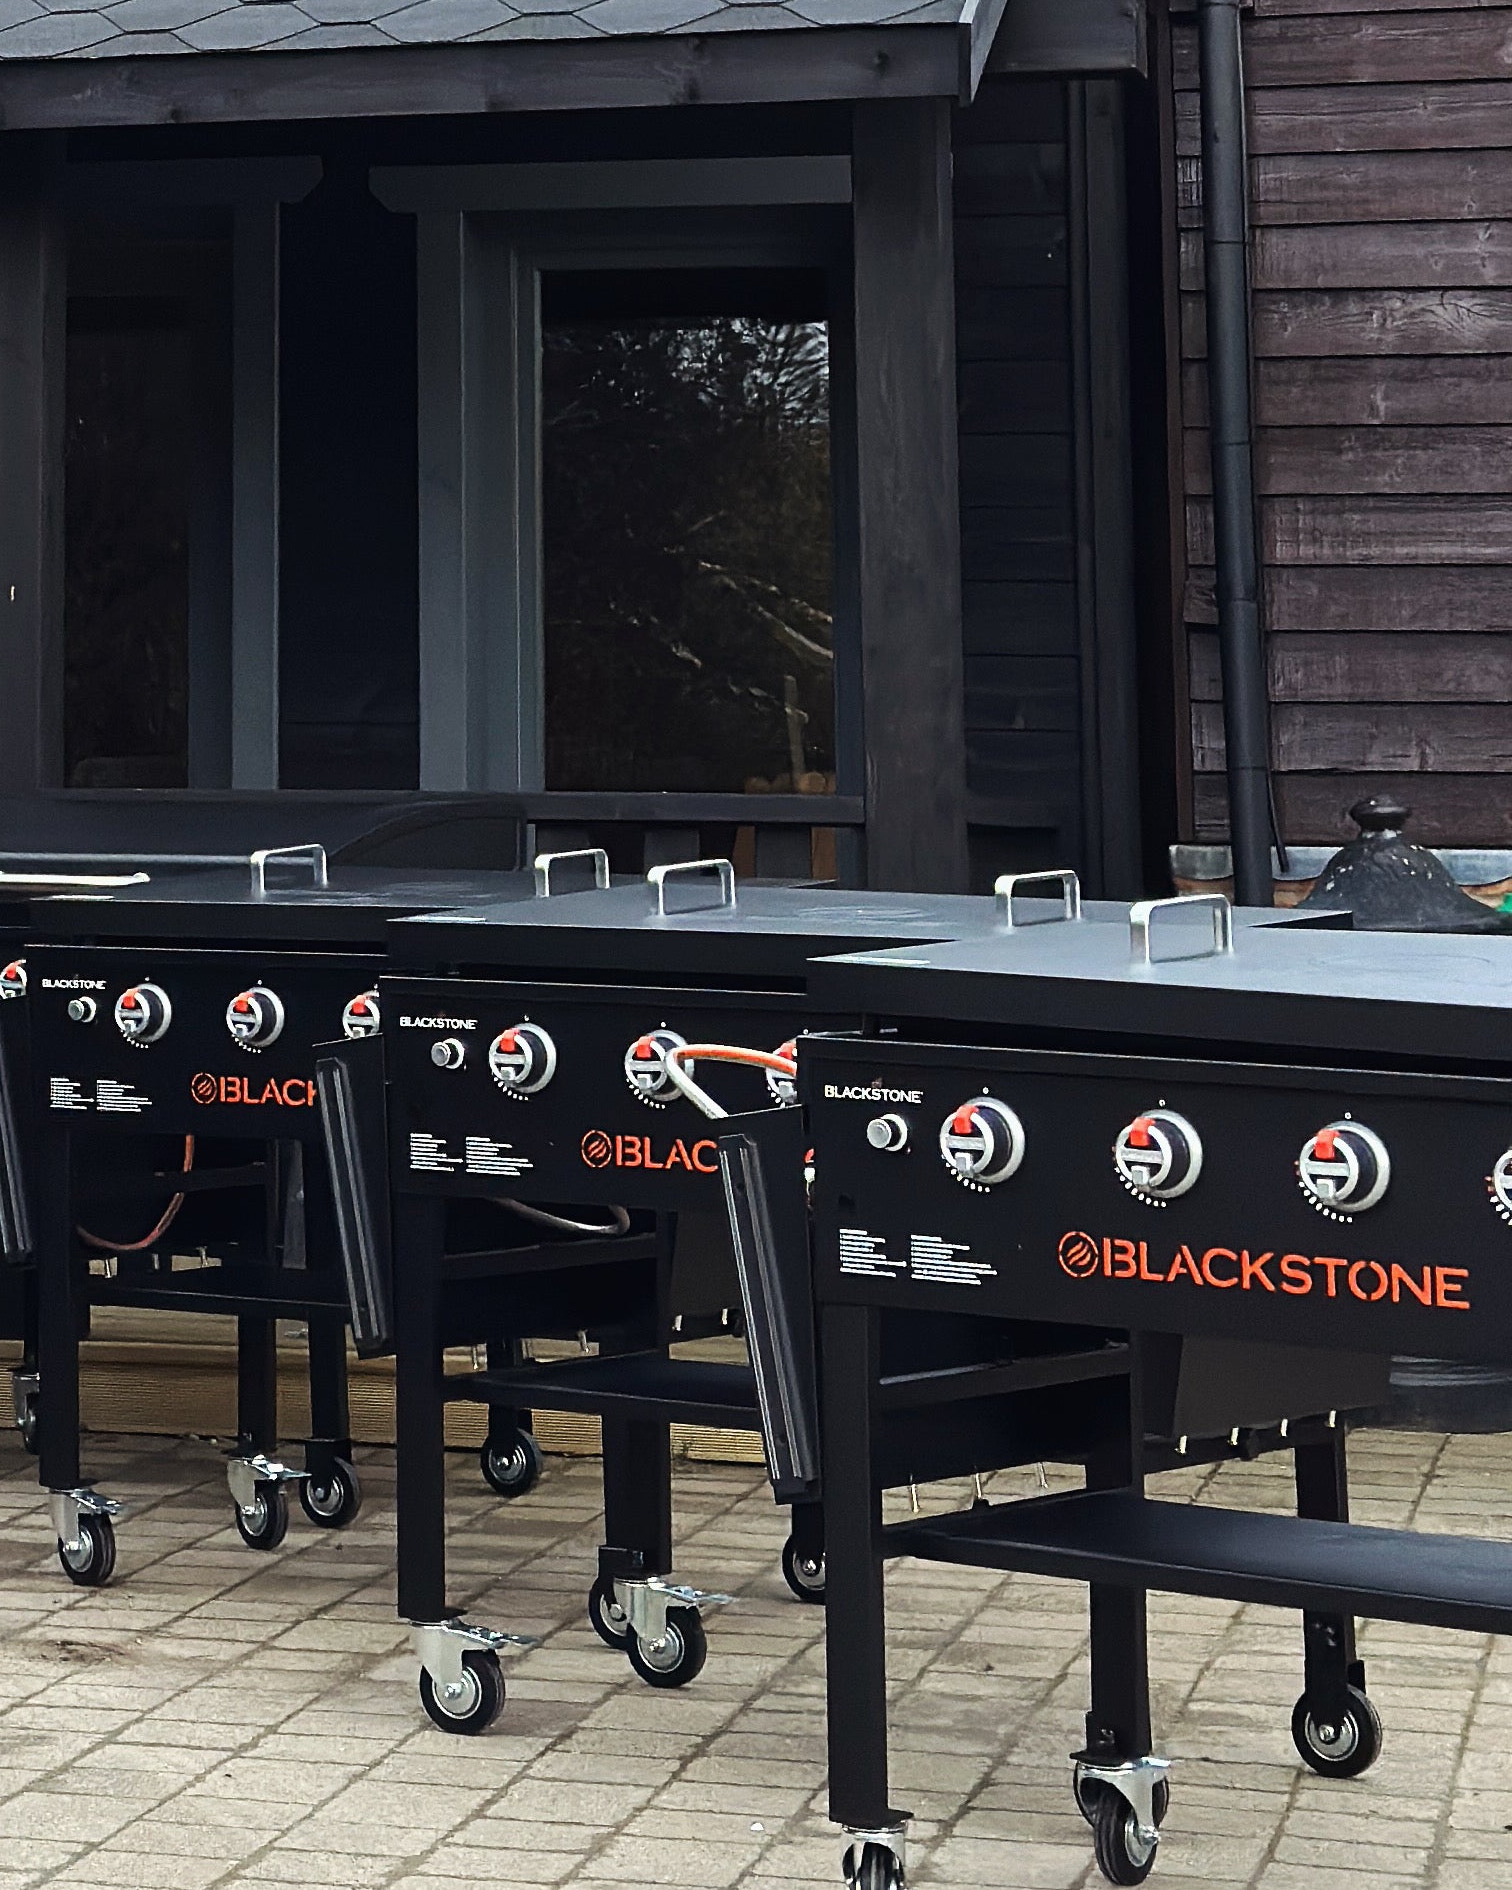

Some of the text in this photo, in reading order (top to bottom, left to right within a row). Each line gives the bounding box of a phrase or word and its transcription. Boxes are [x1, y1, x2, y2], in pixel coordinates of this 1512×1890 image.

[41, 978, 107, 990] BLACKSTONE
[399, 1016, 478, 1030] BLACKSTONE
[824, 1084, 924, 1104] BLACKSTONE
[1102, 1237, 1471, 1310] BLACKSTONE
